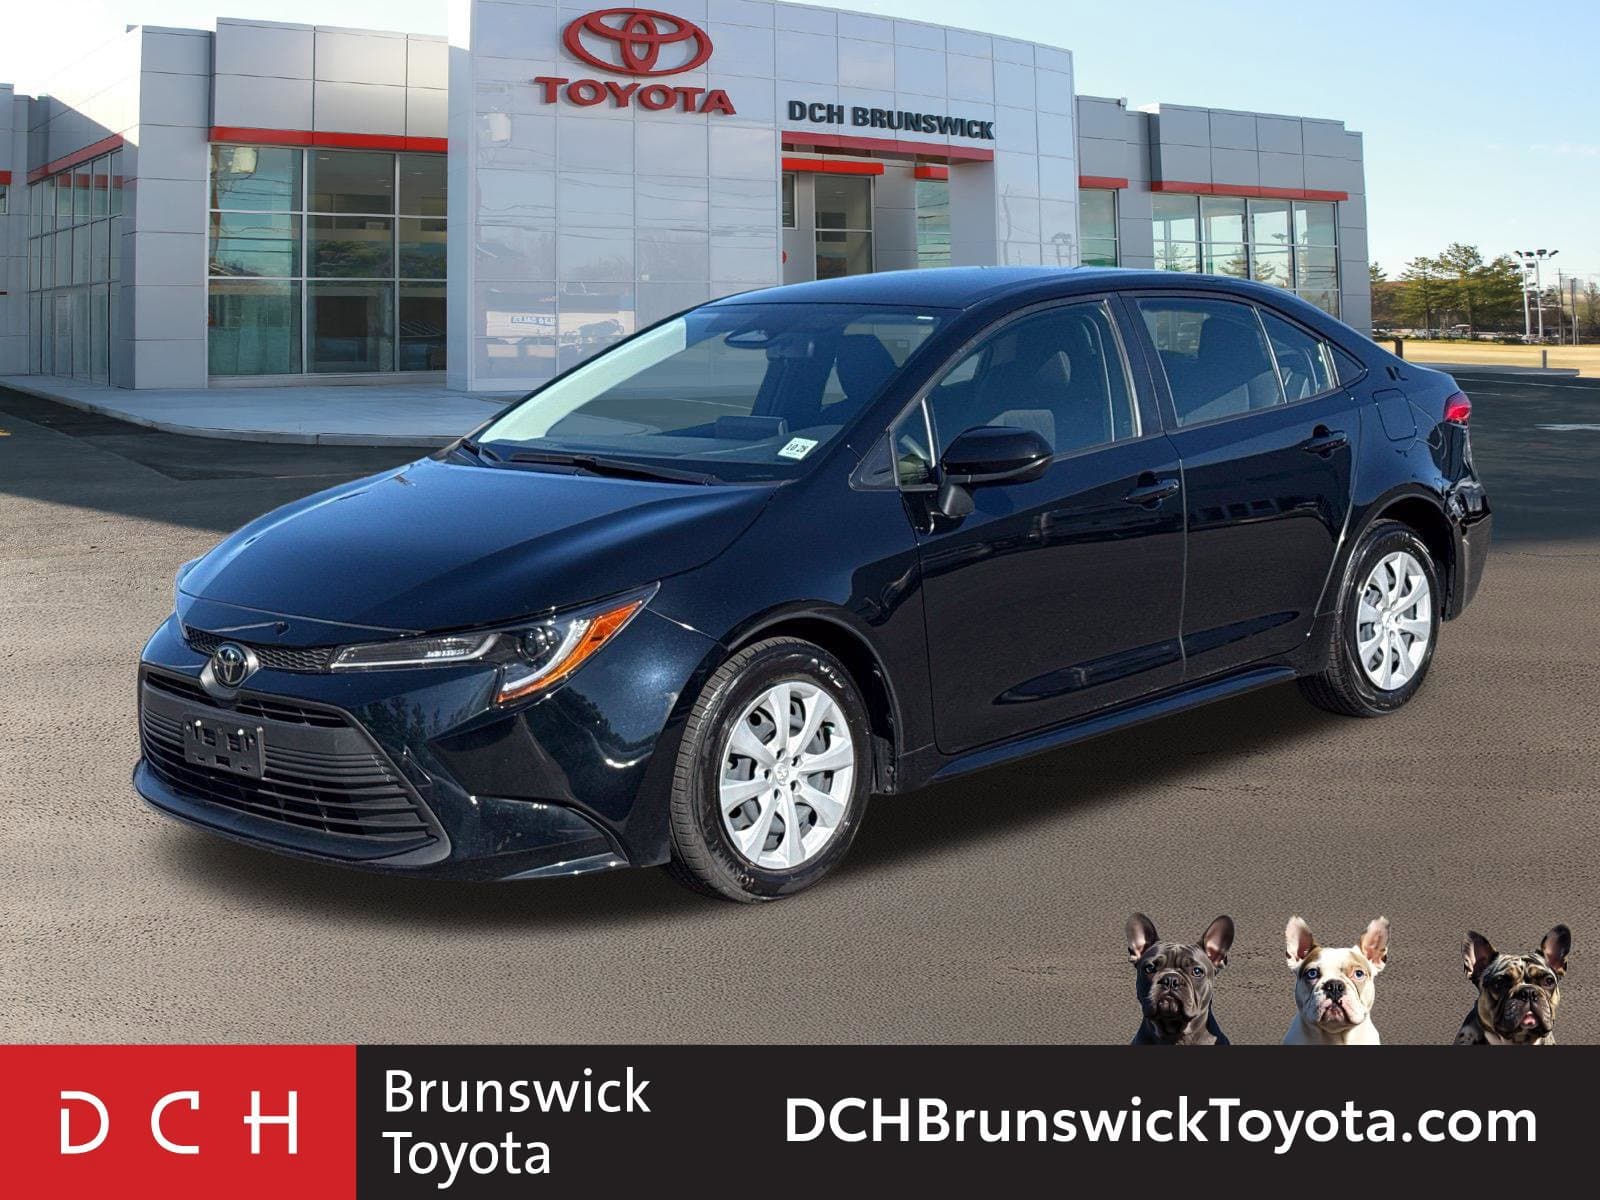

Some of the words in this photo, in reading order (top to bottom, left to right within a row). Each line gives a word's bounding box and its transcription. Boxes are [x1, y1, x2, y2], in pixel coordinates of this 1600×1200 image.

[533, 76, 736, 115] TOYOTA
[788, 100, 845, 125] DCH
[852, 106, 994, 140] BRUNSWICK
